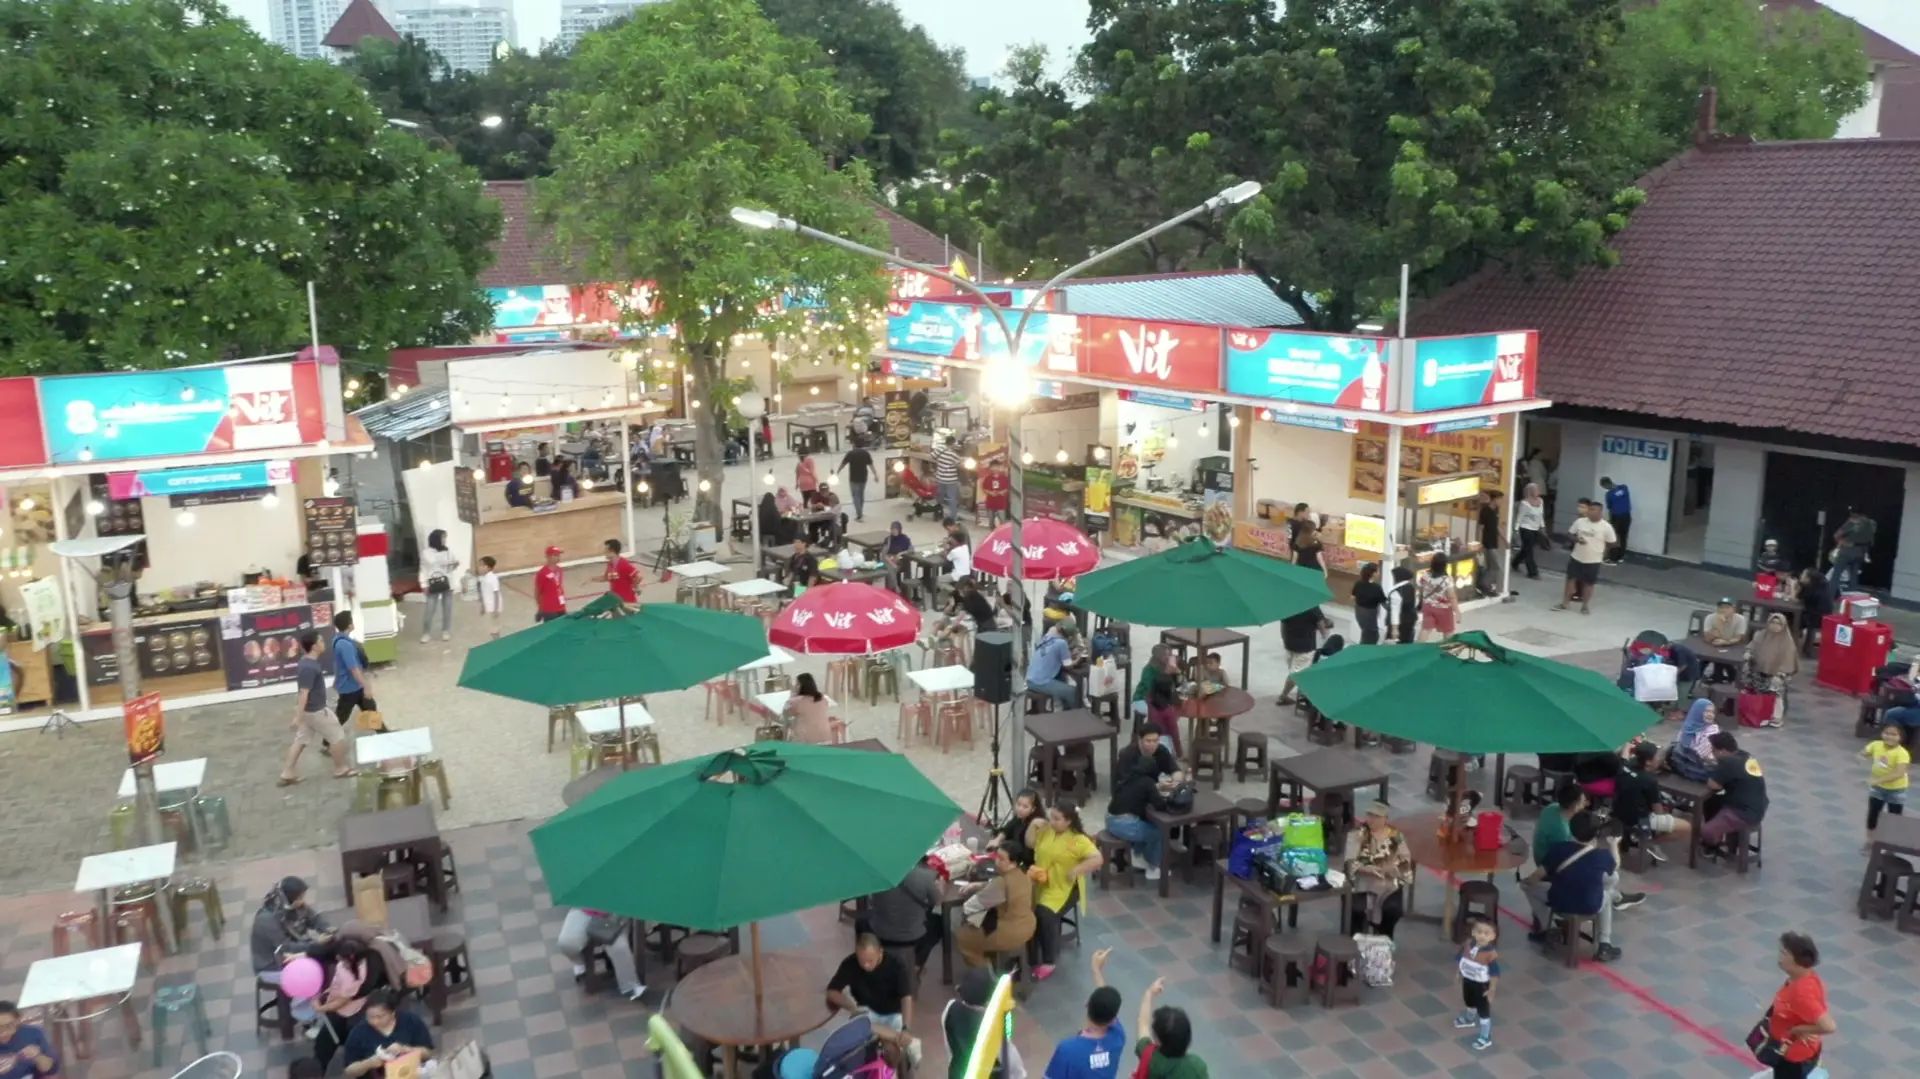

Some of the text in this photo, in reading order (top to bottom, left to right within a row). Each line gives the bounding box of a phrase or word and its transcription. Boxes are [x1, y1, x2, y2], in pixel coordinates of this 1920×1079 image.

[1118, 323, 1180, 381] Vit
[1498, 354, 1522, 380] Vit
[230, 391, 288, 424] Vit
[1603, 436, 1668, 459] TOILET
[1019, 544, 1048, 560] Vit
[823, 611, 857, 629] Vit
[866, 607, 895, 625] Vit
